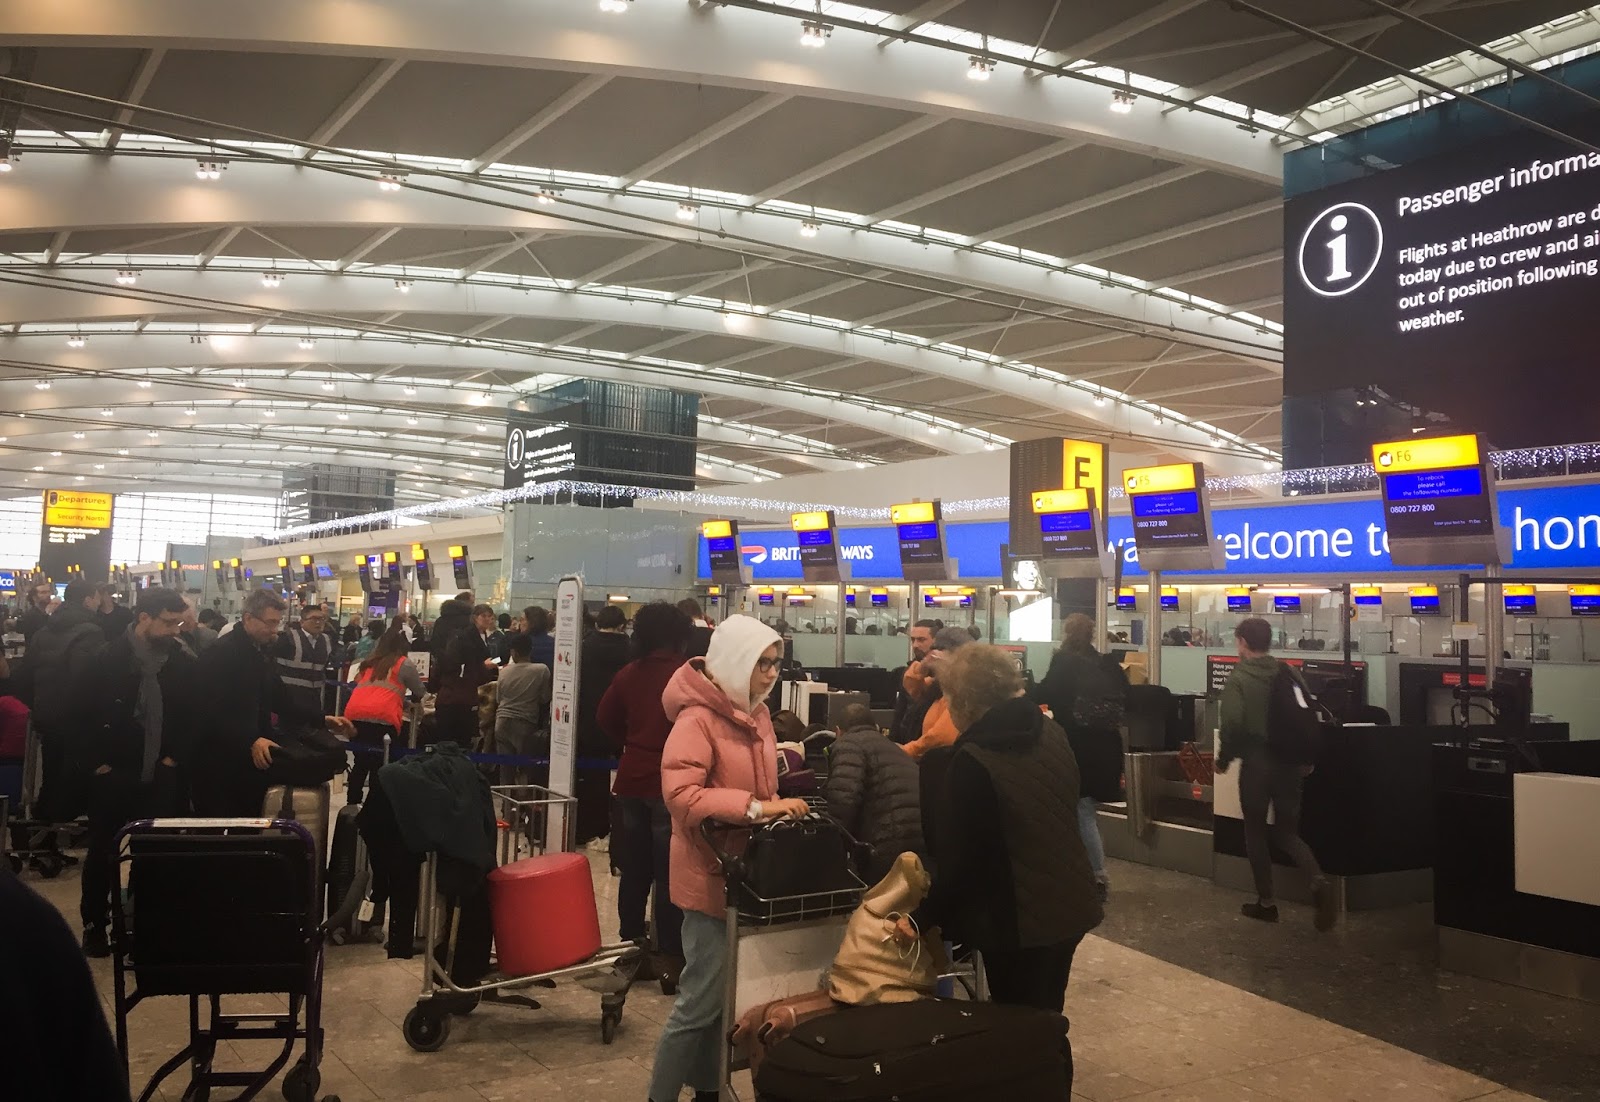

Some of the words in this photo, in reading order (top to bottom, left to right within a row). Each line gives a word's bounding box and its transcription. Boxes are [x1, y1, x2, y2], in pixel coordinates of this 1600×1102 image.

[1399, 174, 1504, 216] Passenger
[1510, 151, 1600, 188] informa
[1399, 240, 1448, 264] Flights
[1451, 236, 1468, 252] at
[1471, 217, 1551, 248] Heathrow
[1557, 211, 1586, 229] are
[1399, 266, 1441, 287] today
[1446, 258, 1475, 277] due
[1478, 253, 1497, 270] to
[1500, 245, 1541, 265] crew
[1546, 234, 1578, 256] and
[1584, 230, 1600, 247] ai
[1399, 292, 1425, 309] out
[1428, 286, 1446, 303] of
[1448, 274, 1513, 303] position
[1517, 258, 1598, 287] following
[1399, 307, 1465, 332] weather.
[1396, 450, 1412, 462] F6
[1075, 456, 1090, 489] F
[1139, 476, 1150, 485] F5
[59, 495, 106, 504] Departures
[1413, 488, 1440, 496] following
[57, 513, 84, 521] Security
[1390, 506, 1407, 514] 0800
[1408, 505, 1421, 513] 727
[1422, 504, 1435, 512] 800
[1216, 522, 1353, 559] elcome
[771, 547, 801, 561] BRIT
[840, 545, 873, 560] WAYS
